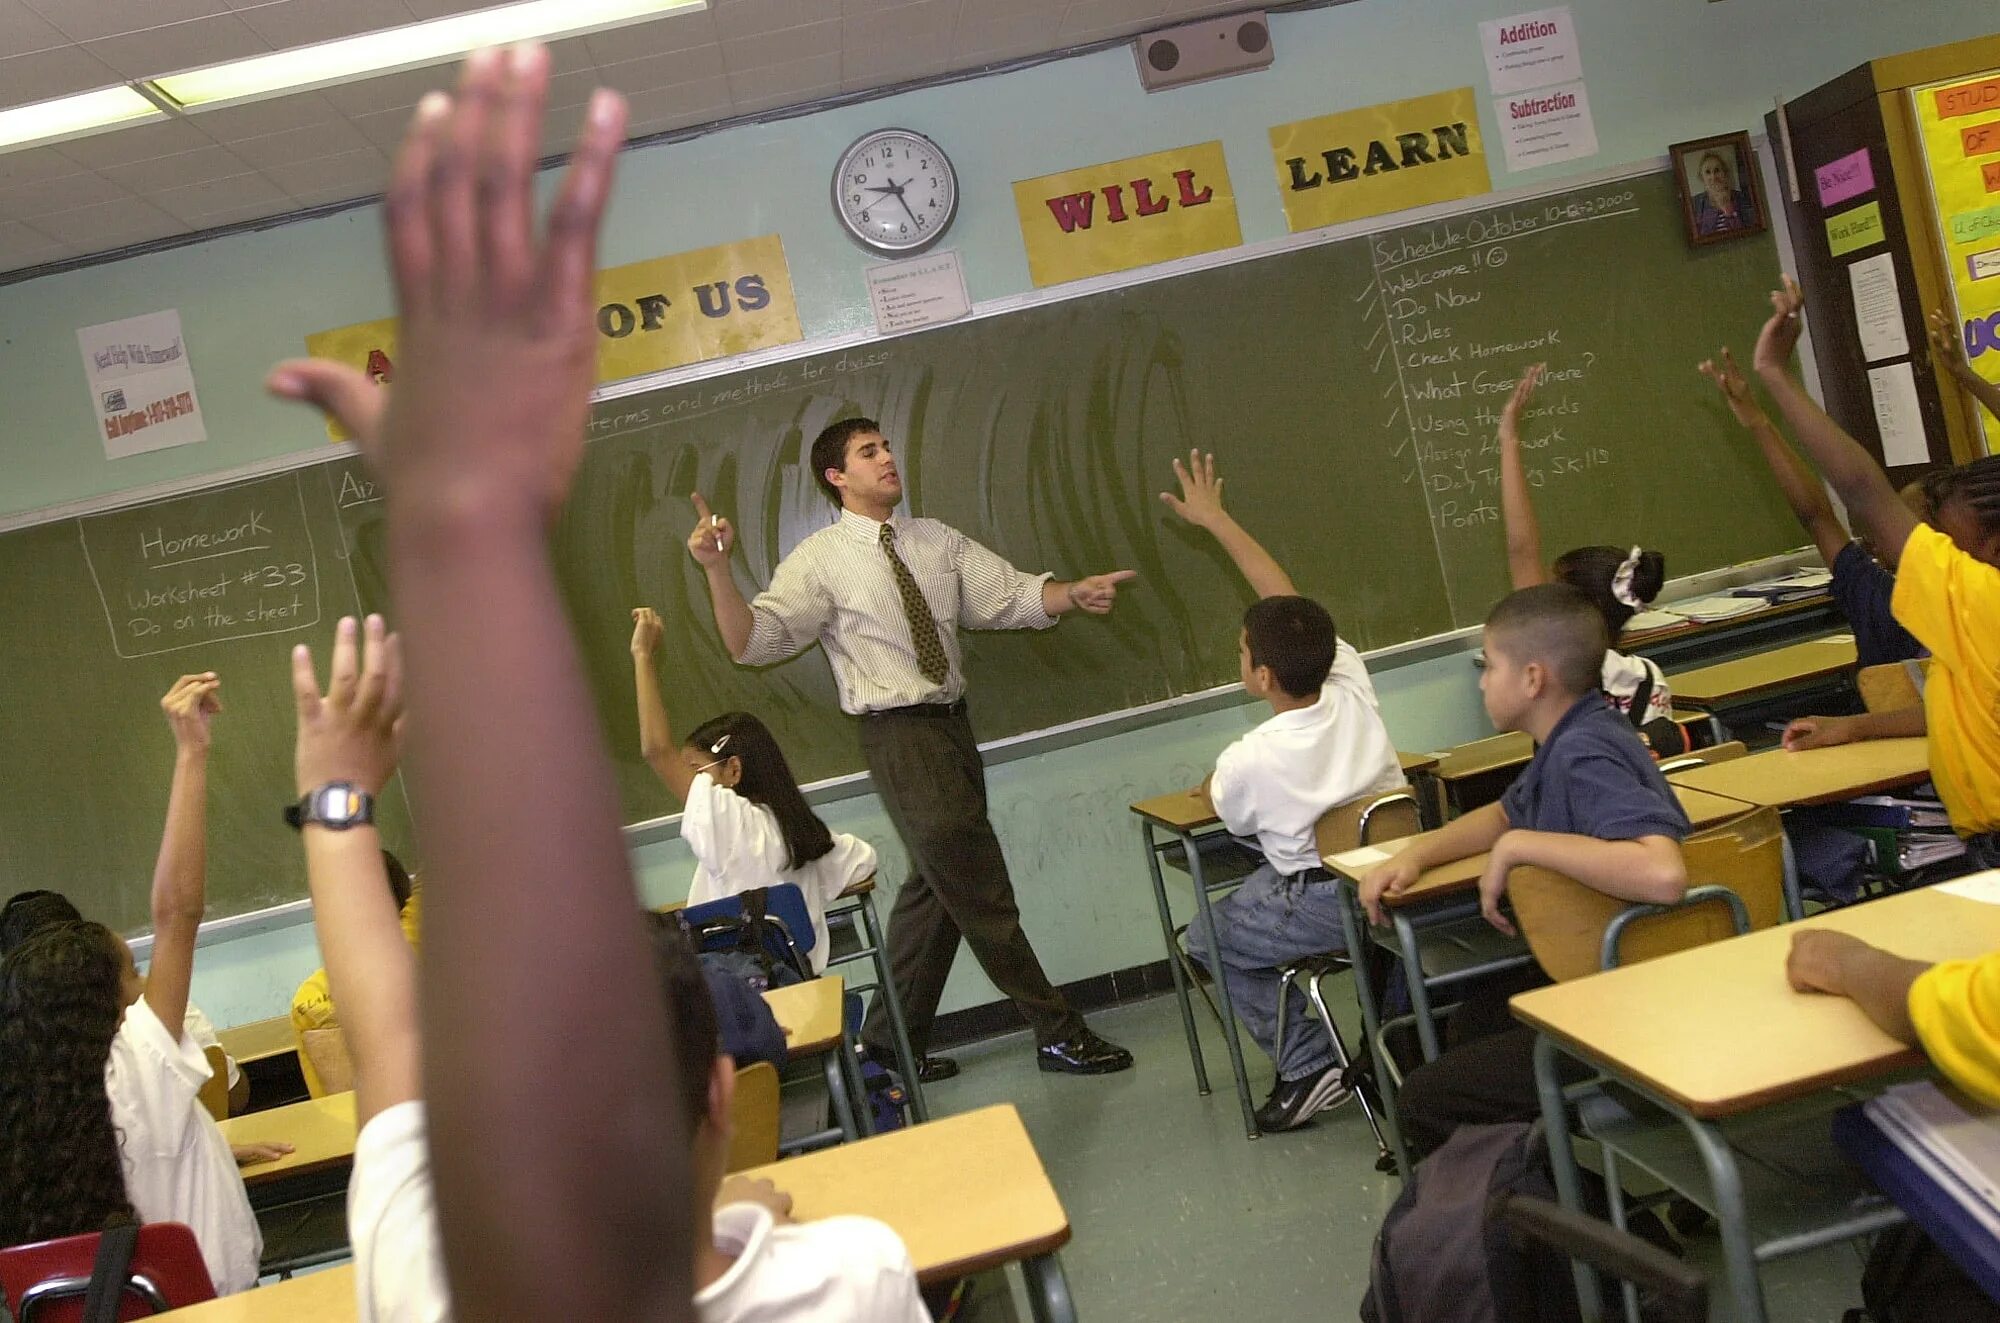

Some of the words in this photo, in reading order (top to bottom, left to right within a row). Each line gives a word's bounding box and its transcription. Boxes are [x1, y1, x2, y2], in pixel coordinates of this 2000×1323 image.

[1500, 20, 1557, 46] Addition
[1510, 91, 1576, 119] Subtraction
[865, 158, 875, 168] 11
[881, 148, 894, 158] 12
[904, 150, 910, 160] 1
[920, 160, 929, 170] 2
[1286, 121, 1469, 192] LEARN
[854, 174, 868, 185] 10
[930, 177, 938, 188] 3
[853, 194, 861, 205] 9
[1046, 168, 1213, 233] WILL
[862, 211, 870, 223] 8
[900, 223, 908, 234] 6
[917, 213, 926, 225] 5
[597, 294, 671, 339] OF
[693, 274, 770, 318] US
[1393, 299, 1426, 319] Do
[1435, 290, 1482, 309] Now
[1402, 324, 1451, 346] Rules
[1408, 347, 1462, 368] Check
[1469, 330, 1561, 359] Homework
[586, 407, 650, 431] terms
[662, 391, 703, 414] and
[800, 361, 827, 379] for
[1411, 371, 1468, 400] What
[1472, 371, 1515, 395] Goes
[1417, 414, 1469, 435] Using
[1520, 399, 1580, 421] oards
[140, 511, 272, 559] Homework
[128, 573, 232, 610] Worksheet
[240, 563, 306, 587] #33
[128, 618, 161, 637] Do
[174, 616, 194, 630] on
[204, 604, 235, 627] the
[244, 594, 303, 622] sheet
